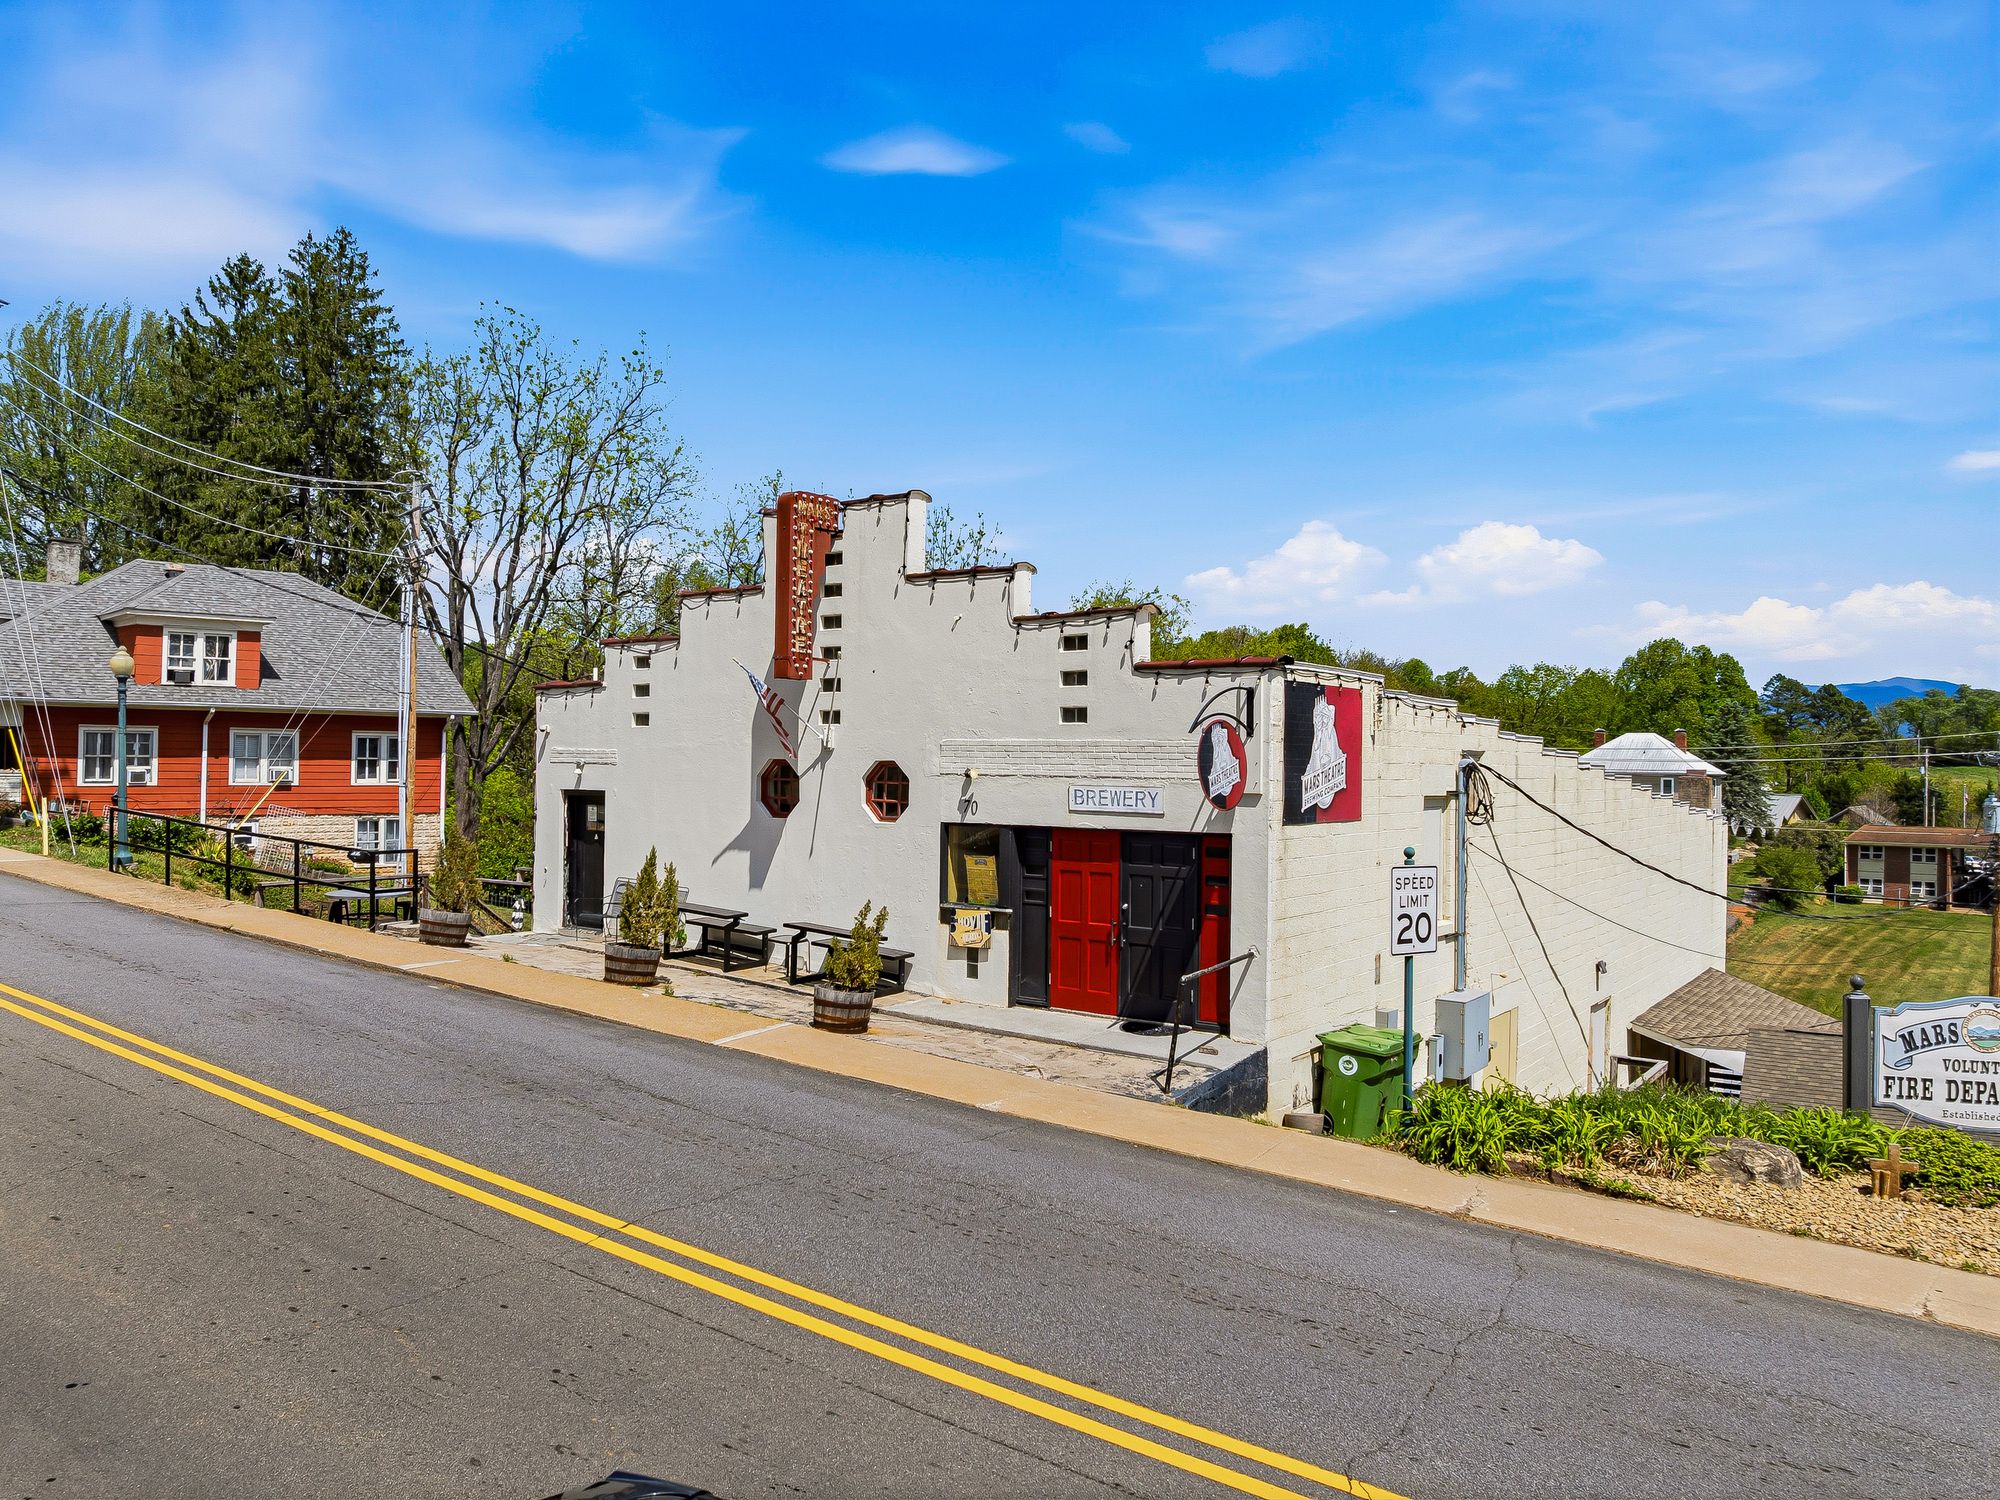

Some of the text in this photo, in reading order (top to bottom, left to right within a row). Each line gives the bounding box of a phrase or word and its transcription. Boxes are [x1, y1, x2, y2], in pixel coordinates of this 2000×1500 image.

[796, 521, 809, 654] THEATRE
[1303, 760, 1345, 795] MARS THEATRE
[963, 799, 978, 816] 70
[1073, 788, 1159, 808] BREWERY
[1395, 876, 1434, 891] SPEED
[1399, 894, 1430, 909] LIMIT
[1396, 911, 1432, 945] 20
[1898, 1022, 1960, 1054] MARS
[1942, 1058, 2000, 1075] VOLUNT
[1883, 1075, 2000, 1106] FIRE DEPA
